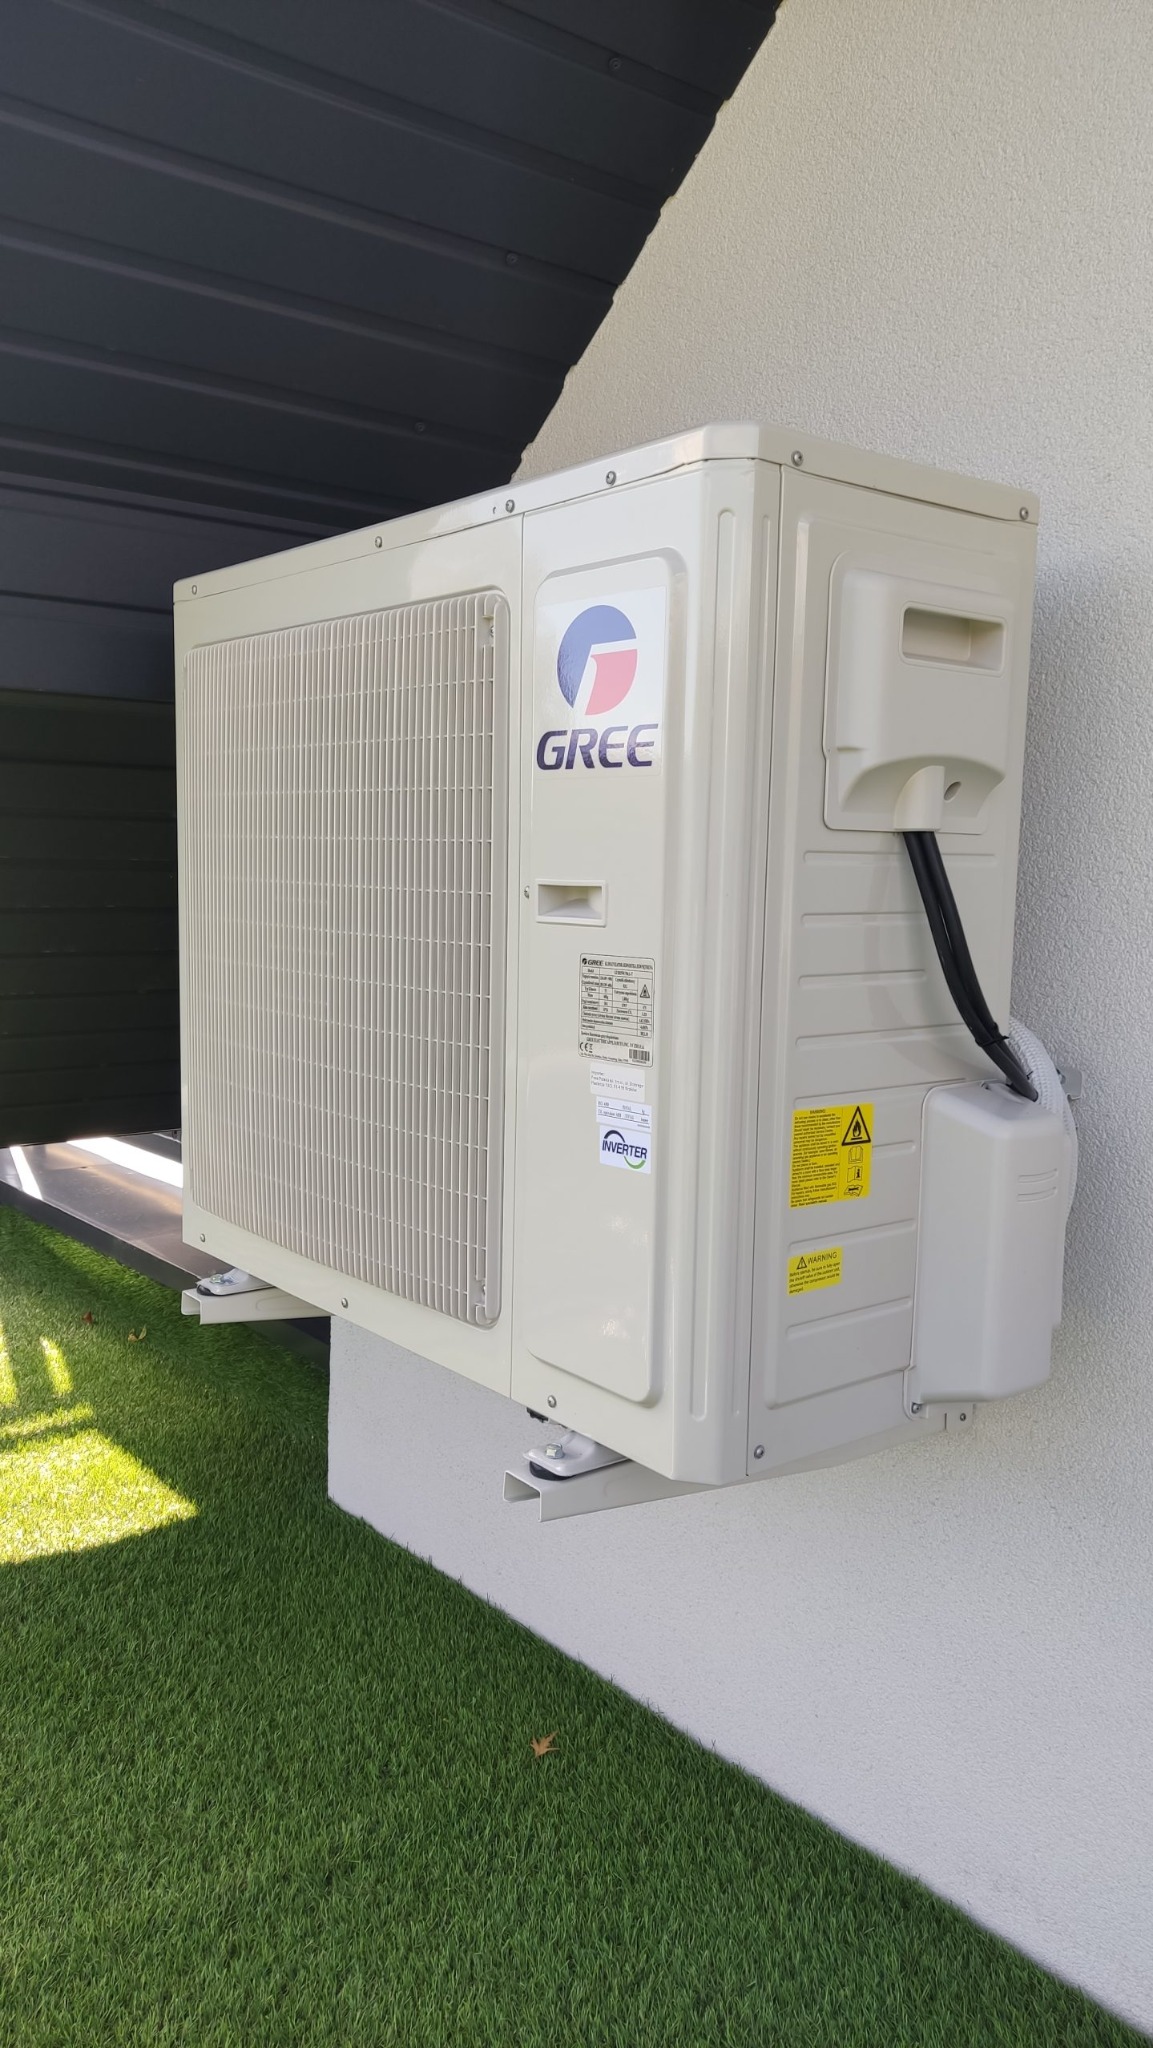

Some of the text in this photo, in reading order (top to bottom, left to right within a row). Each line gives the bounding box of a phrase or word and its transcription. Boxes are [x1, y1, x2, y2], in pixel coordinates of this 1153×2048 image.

[536, 723, 659, 770] GREE
[602, 1140, 648, 1160] INVERTER
[808, 1252, 838, 1265] WARNING
